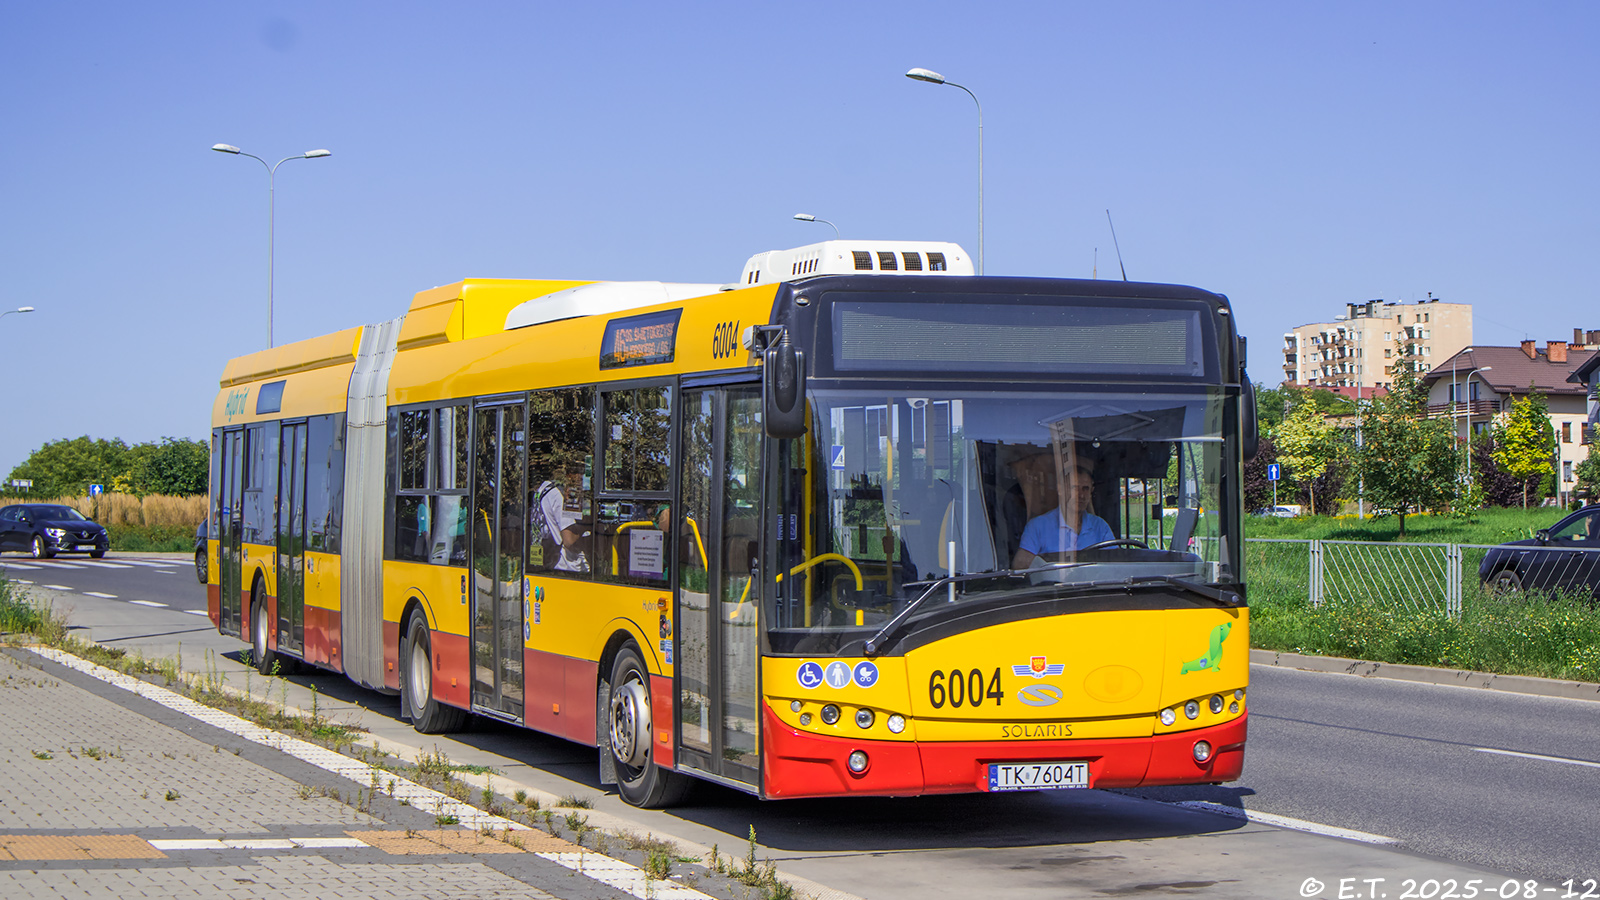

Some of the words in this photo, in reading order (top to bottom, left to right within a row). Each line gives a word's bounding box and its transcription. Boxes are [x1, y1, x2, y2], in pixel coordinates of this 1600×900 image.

[713, 320, 740, 360] 6004
[929, 667, 1004, 709] 6004
[1002, 725, 1073, 738] SOLARIS
[1002, 766, 1025, 784] TK
[1032, 765, 1085, 784] 7604T
